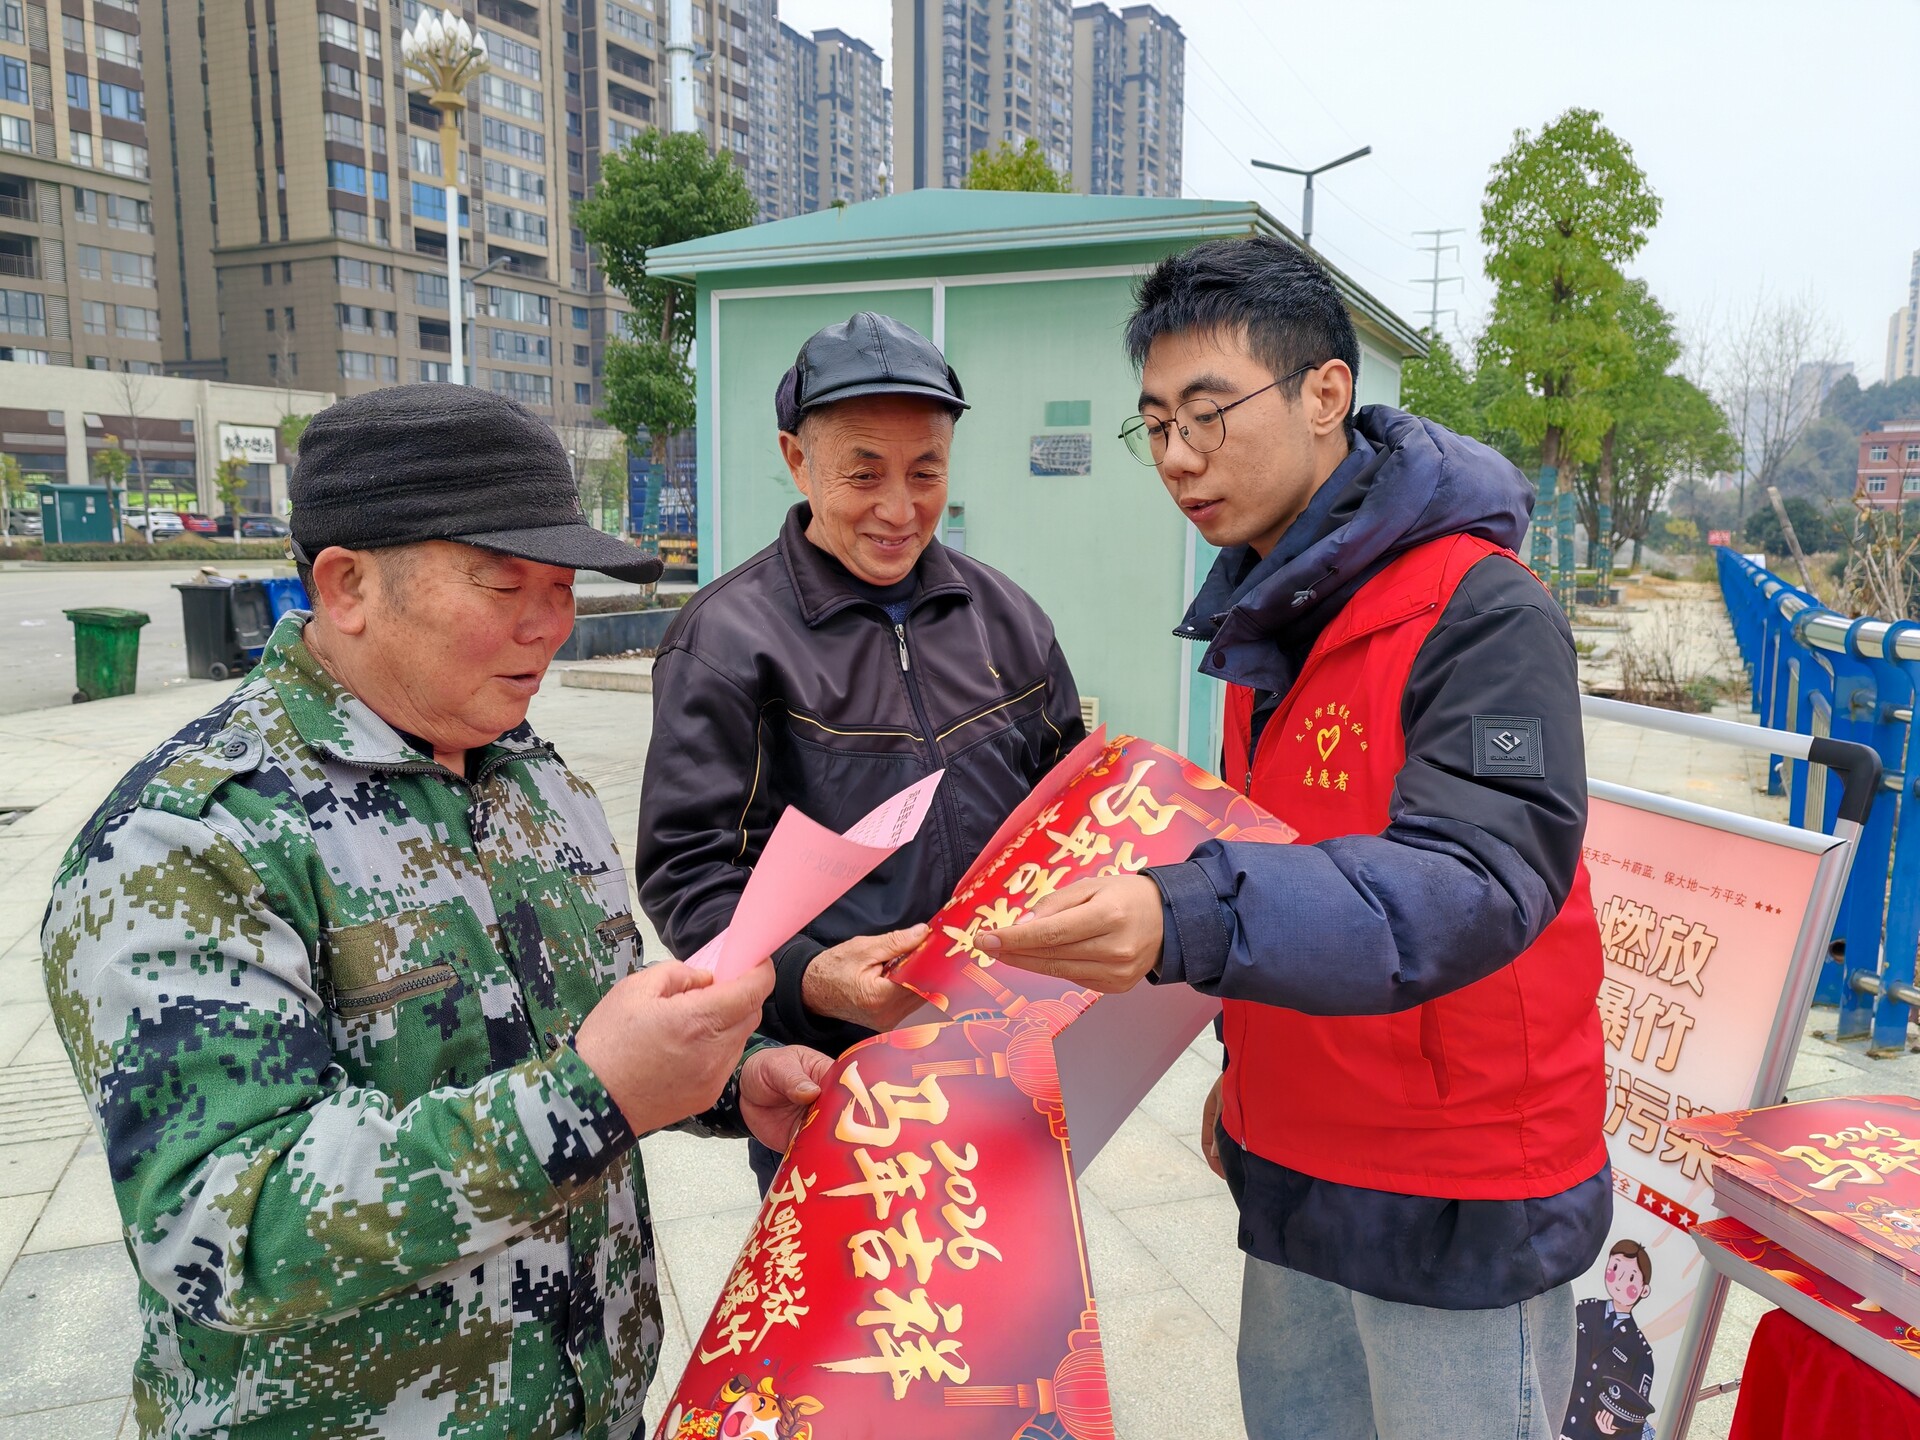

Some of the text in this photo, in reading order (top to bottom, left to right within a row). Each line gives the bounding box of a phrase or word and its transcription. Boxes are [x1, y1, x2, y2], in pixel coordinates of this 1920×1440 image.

[1303, 765, 1349, 791] 志愿者
[1593, 895, 1719, 998] 燃放
[1808, 1120, 1900, 1150] 2026
[749, 1165, 818, 1354] 文明燃放
[813, 1061, 971, 1400] 马年吉祥
[931, 1140, 1003, 1270] 2026
